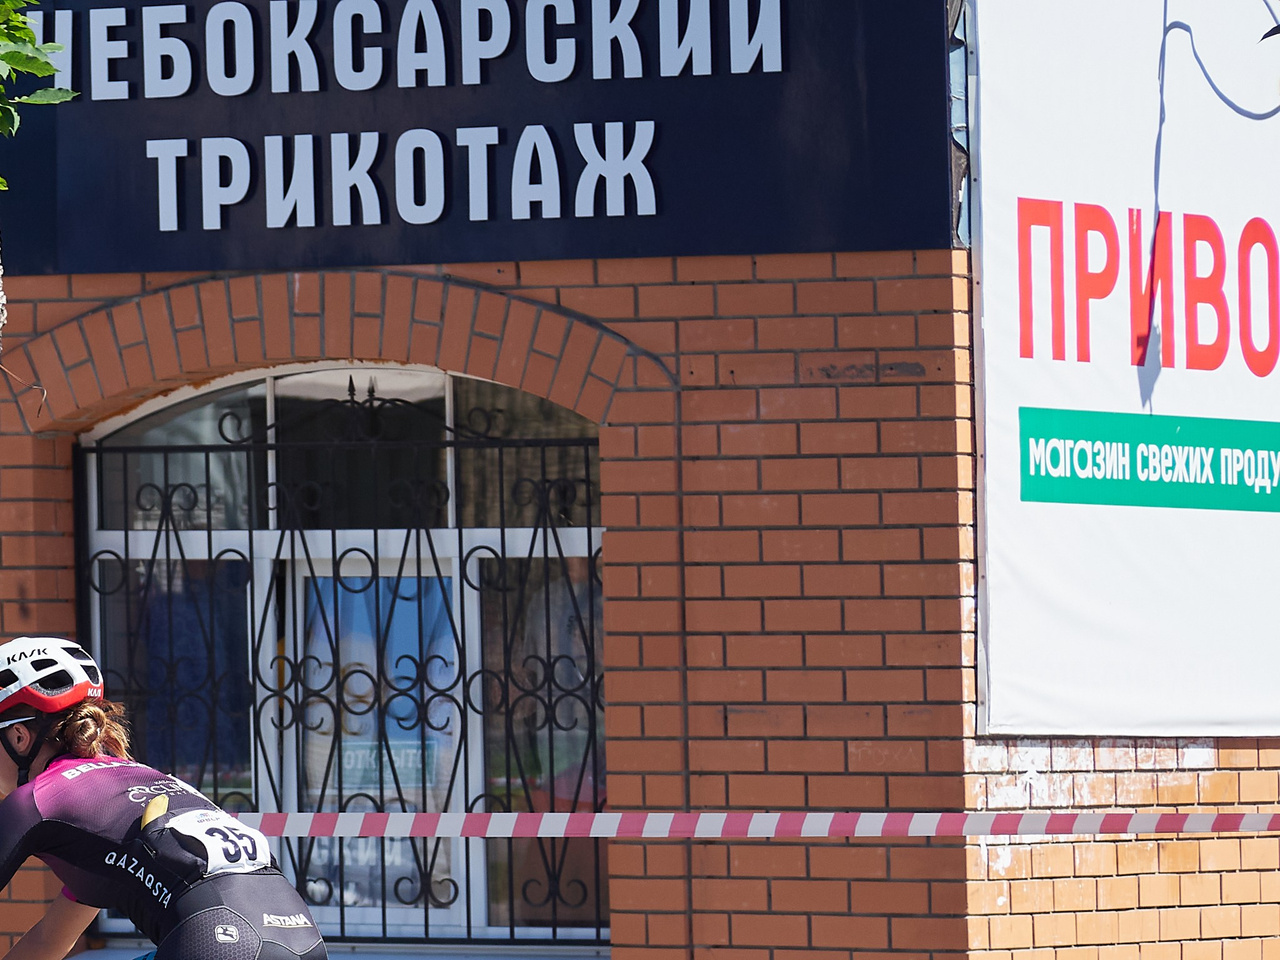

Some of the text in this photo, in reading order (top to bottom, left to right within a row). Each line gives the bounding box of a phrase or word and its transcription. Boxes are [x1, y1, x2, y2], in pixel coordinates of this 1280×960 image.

[146, 121, 657, 232] ТРИКОТАЖ
[1017, 197, 1280, 378] ПРИВО
[1028, 437, 1131, 480] магазин
[1136, 443, 1215, 484] свежих
[6, 648, 49, 666] KASK
[204, 826, 258, 863] 35
[263, 913, 312, 926] ASTANA
